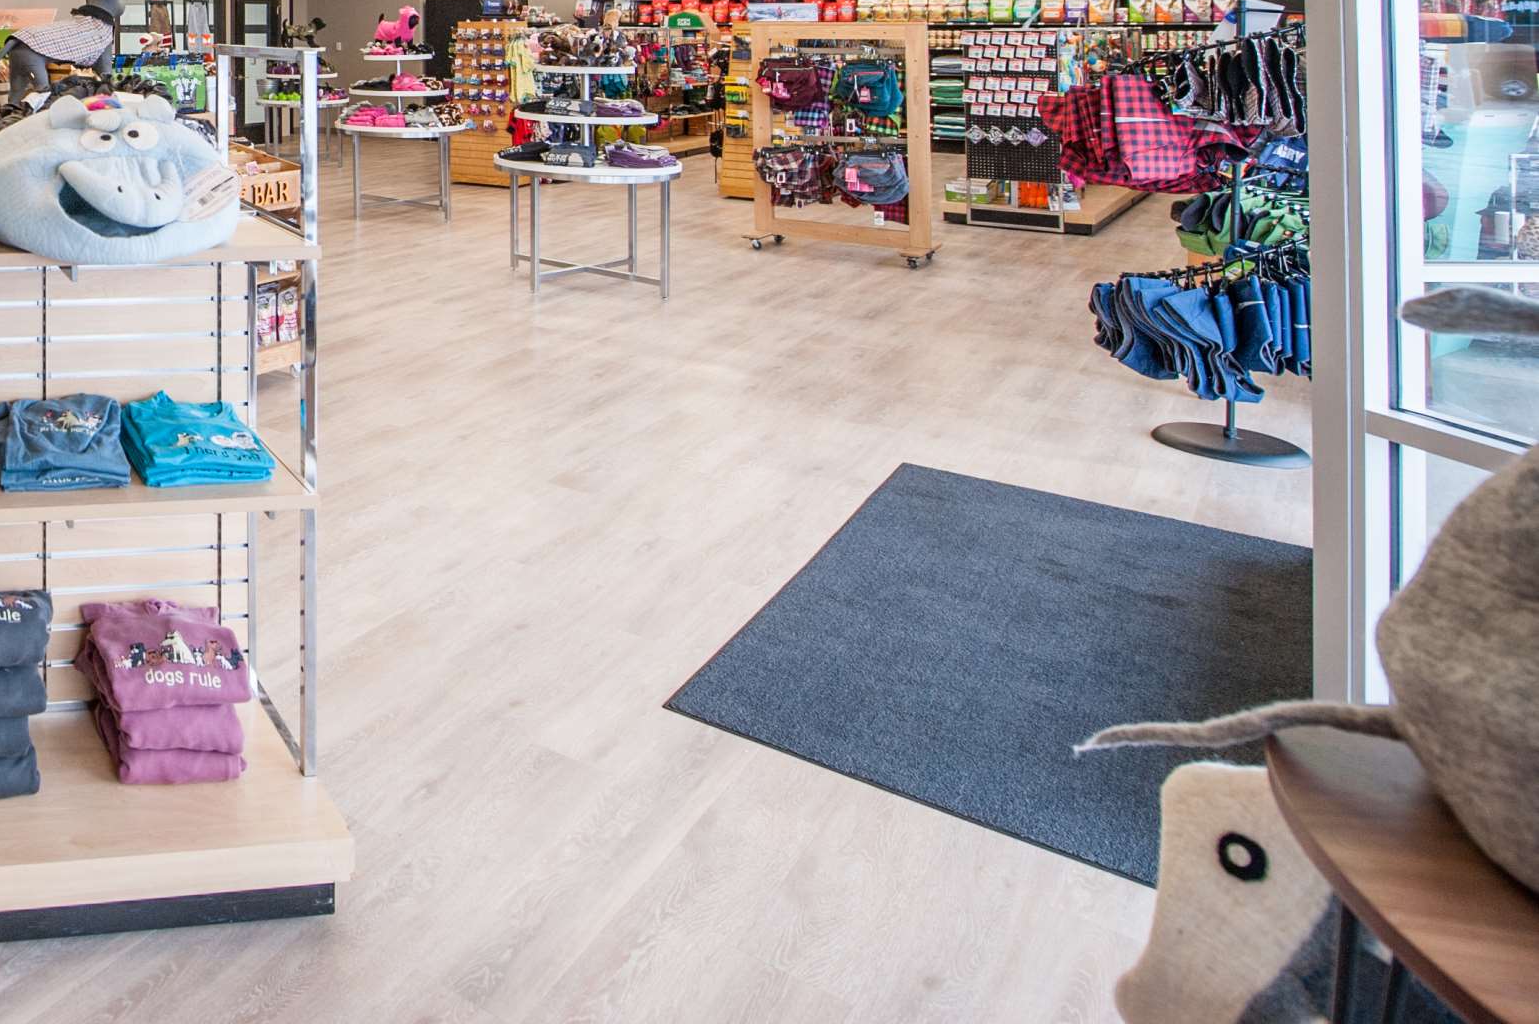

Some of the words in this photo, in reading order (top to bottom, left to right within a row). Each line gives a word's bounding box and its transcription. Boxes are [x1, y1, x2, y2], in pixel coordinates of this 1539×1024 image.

[252, 180, 289, 206] BAR
[145, 667, 184, 687] dogs
[189, 671, 222, 689] rule
